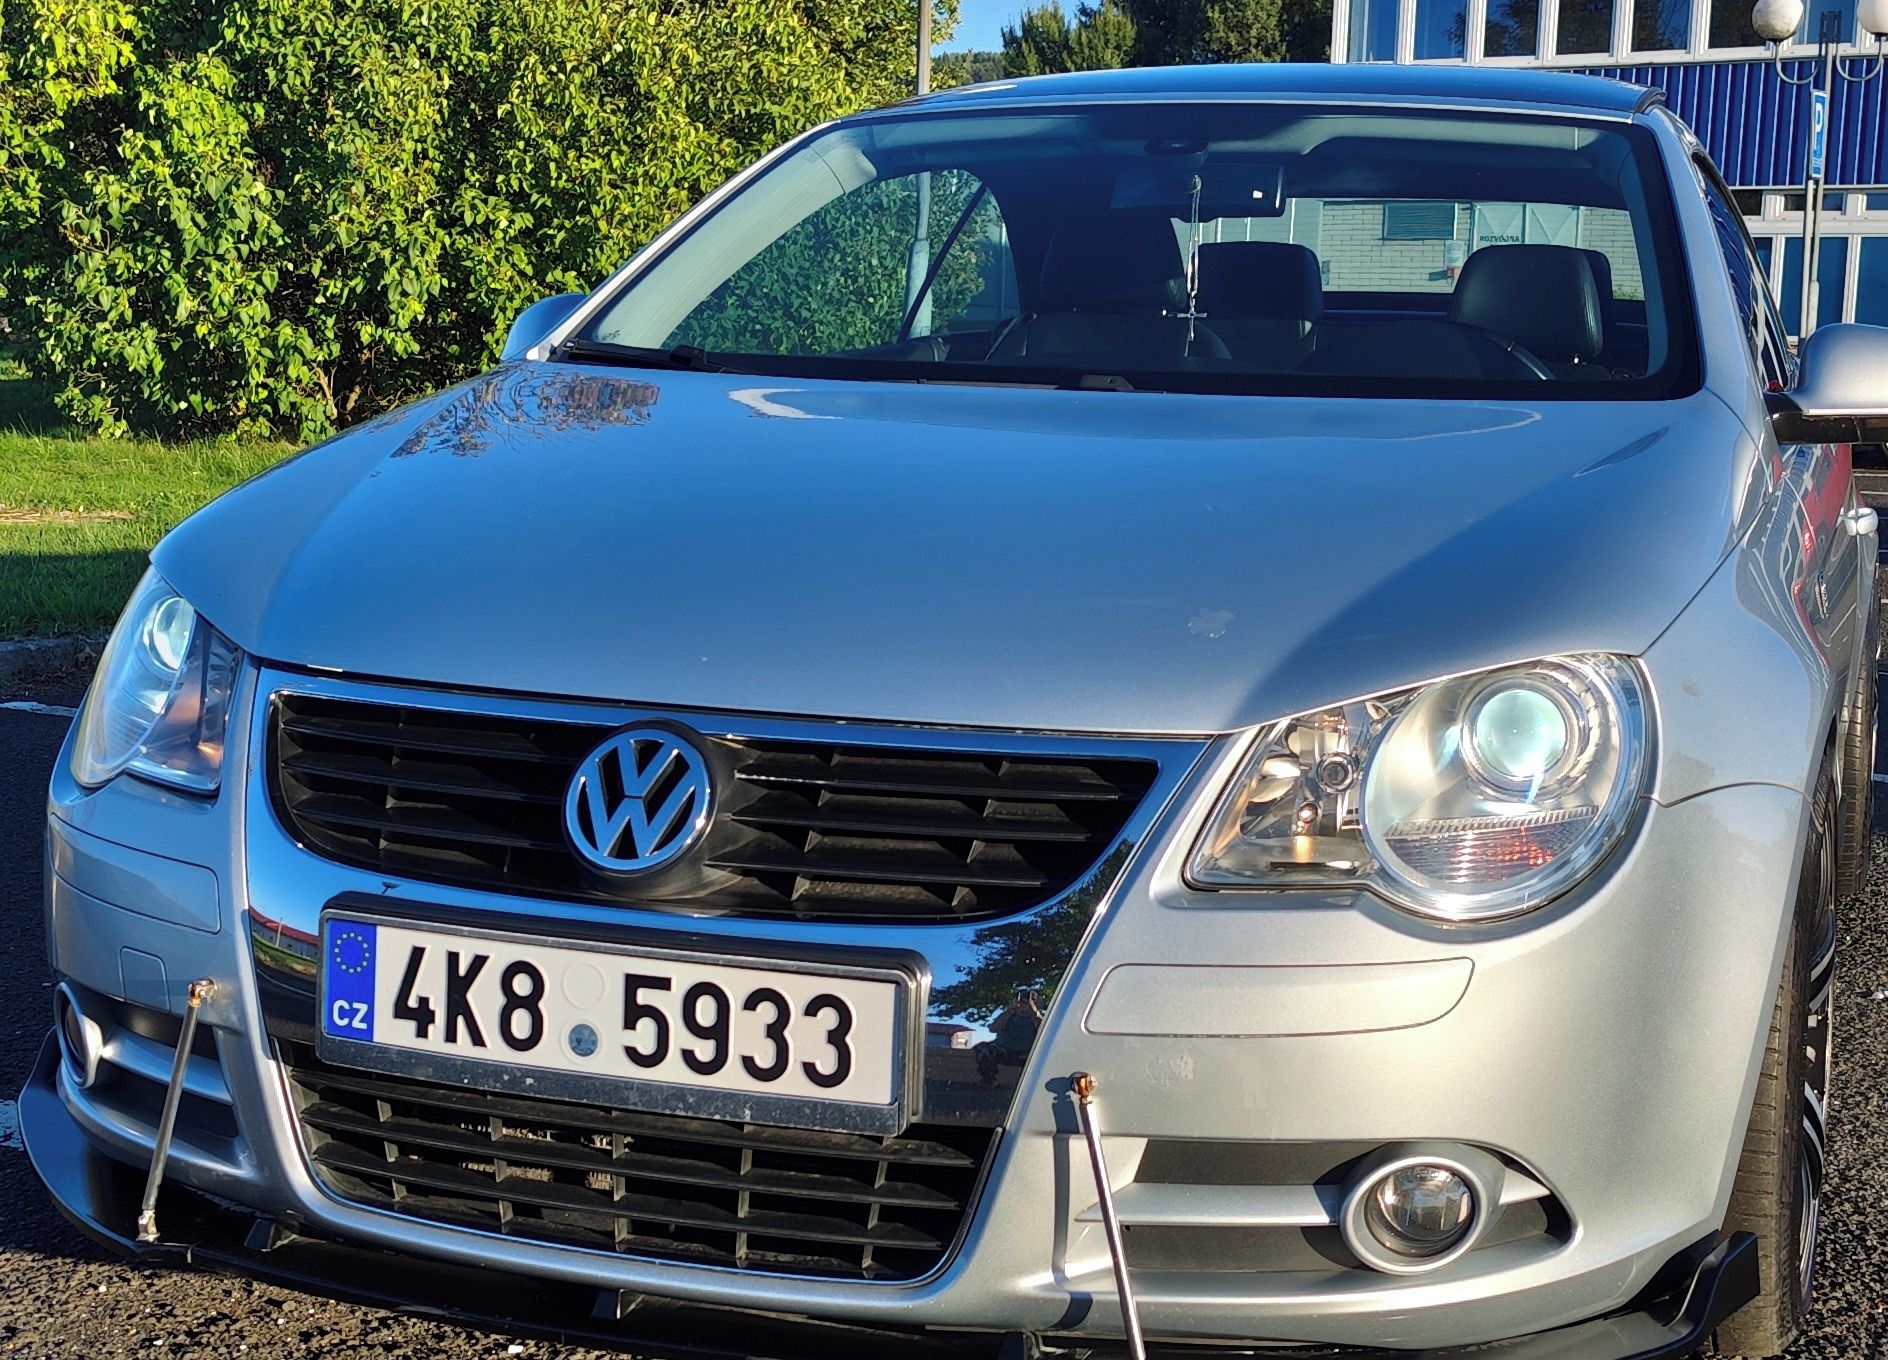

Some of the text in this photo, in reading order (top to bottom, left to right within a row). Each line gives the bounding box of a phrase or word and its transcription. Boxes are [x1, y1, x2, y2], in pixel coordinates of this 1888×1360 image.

[1814, 103, 1823, 150] P
[571, 733, 705, 865] VW
[332, 999, 369, 1030] CZ
[393, 945, 854, 1089] 4K8 5933
